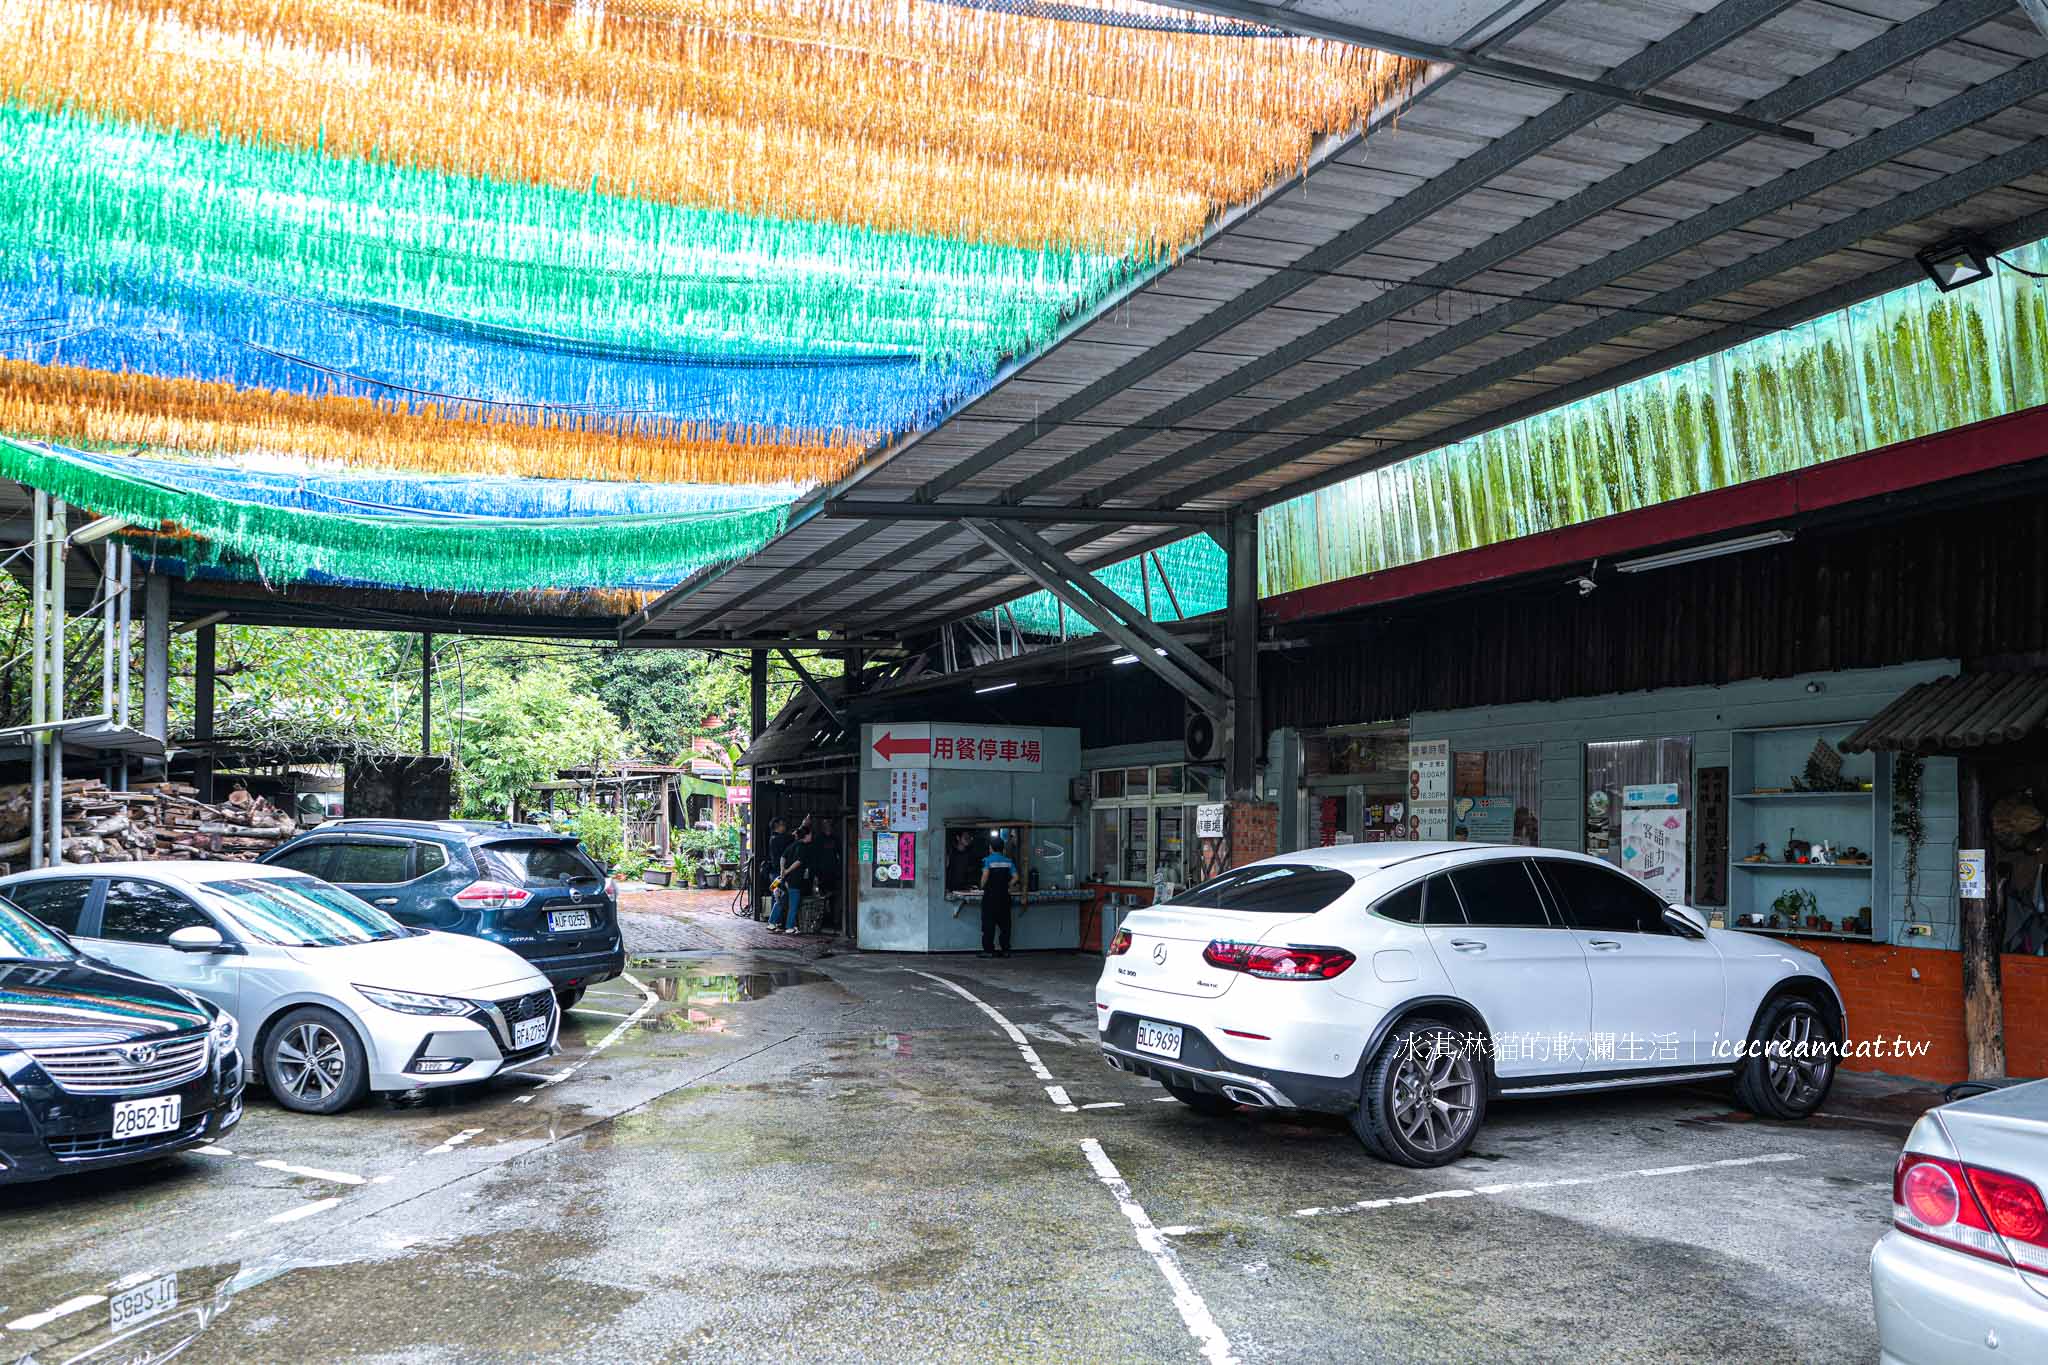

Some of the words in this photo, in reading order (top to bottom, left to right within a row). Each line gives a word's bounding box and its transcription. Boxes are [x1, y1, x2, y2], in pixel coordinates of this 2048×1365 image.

[934, 737, 1041, 763] 用餐停車場
